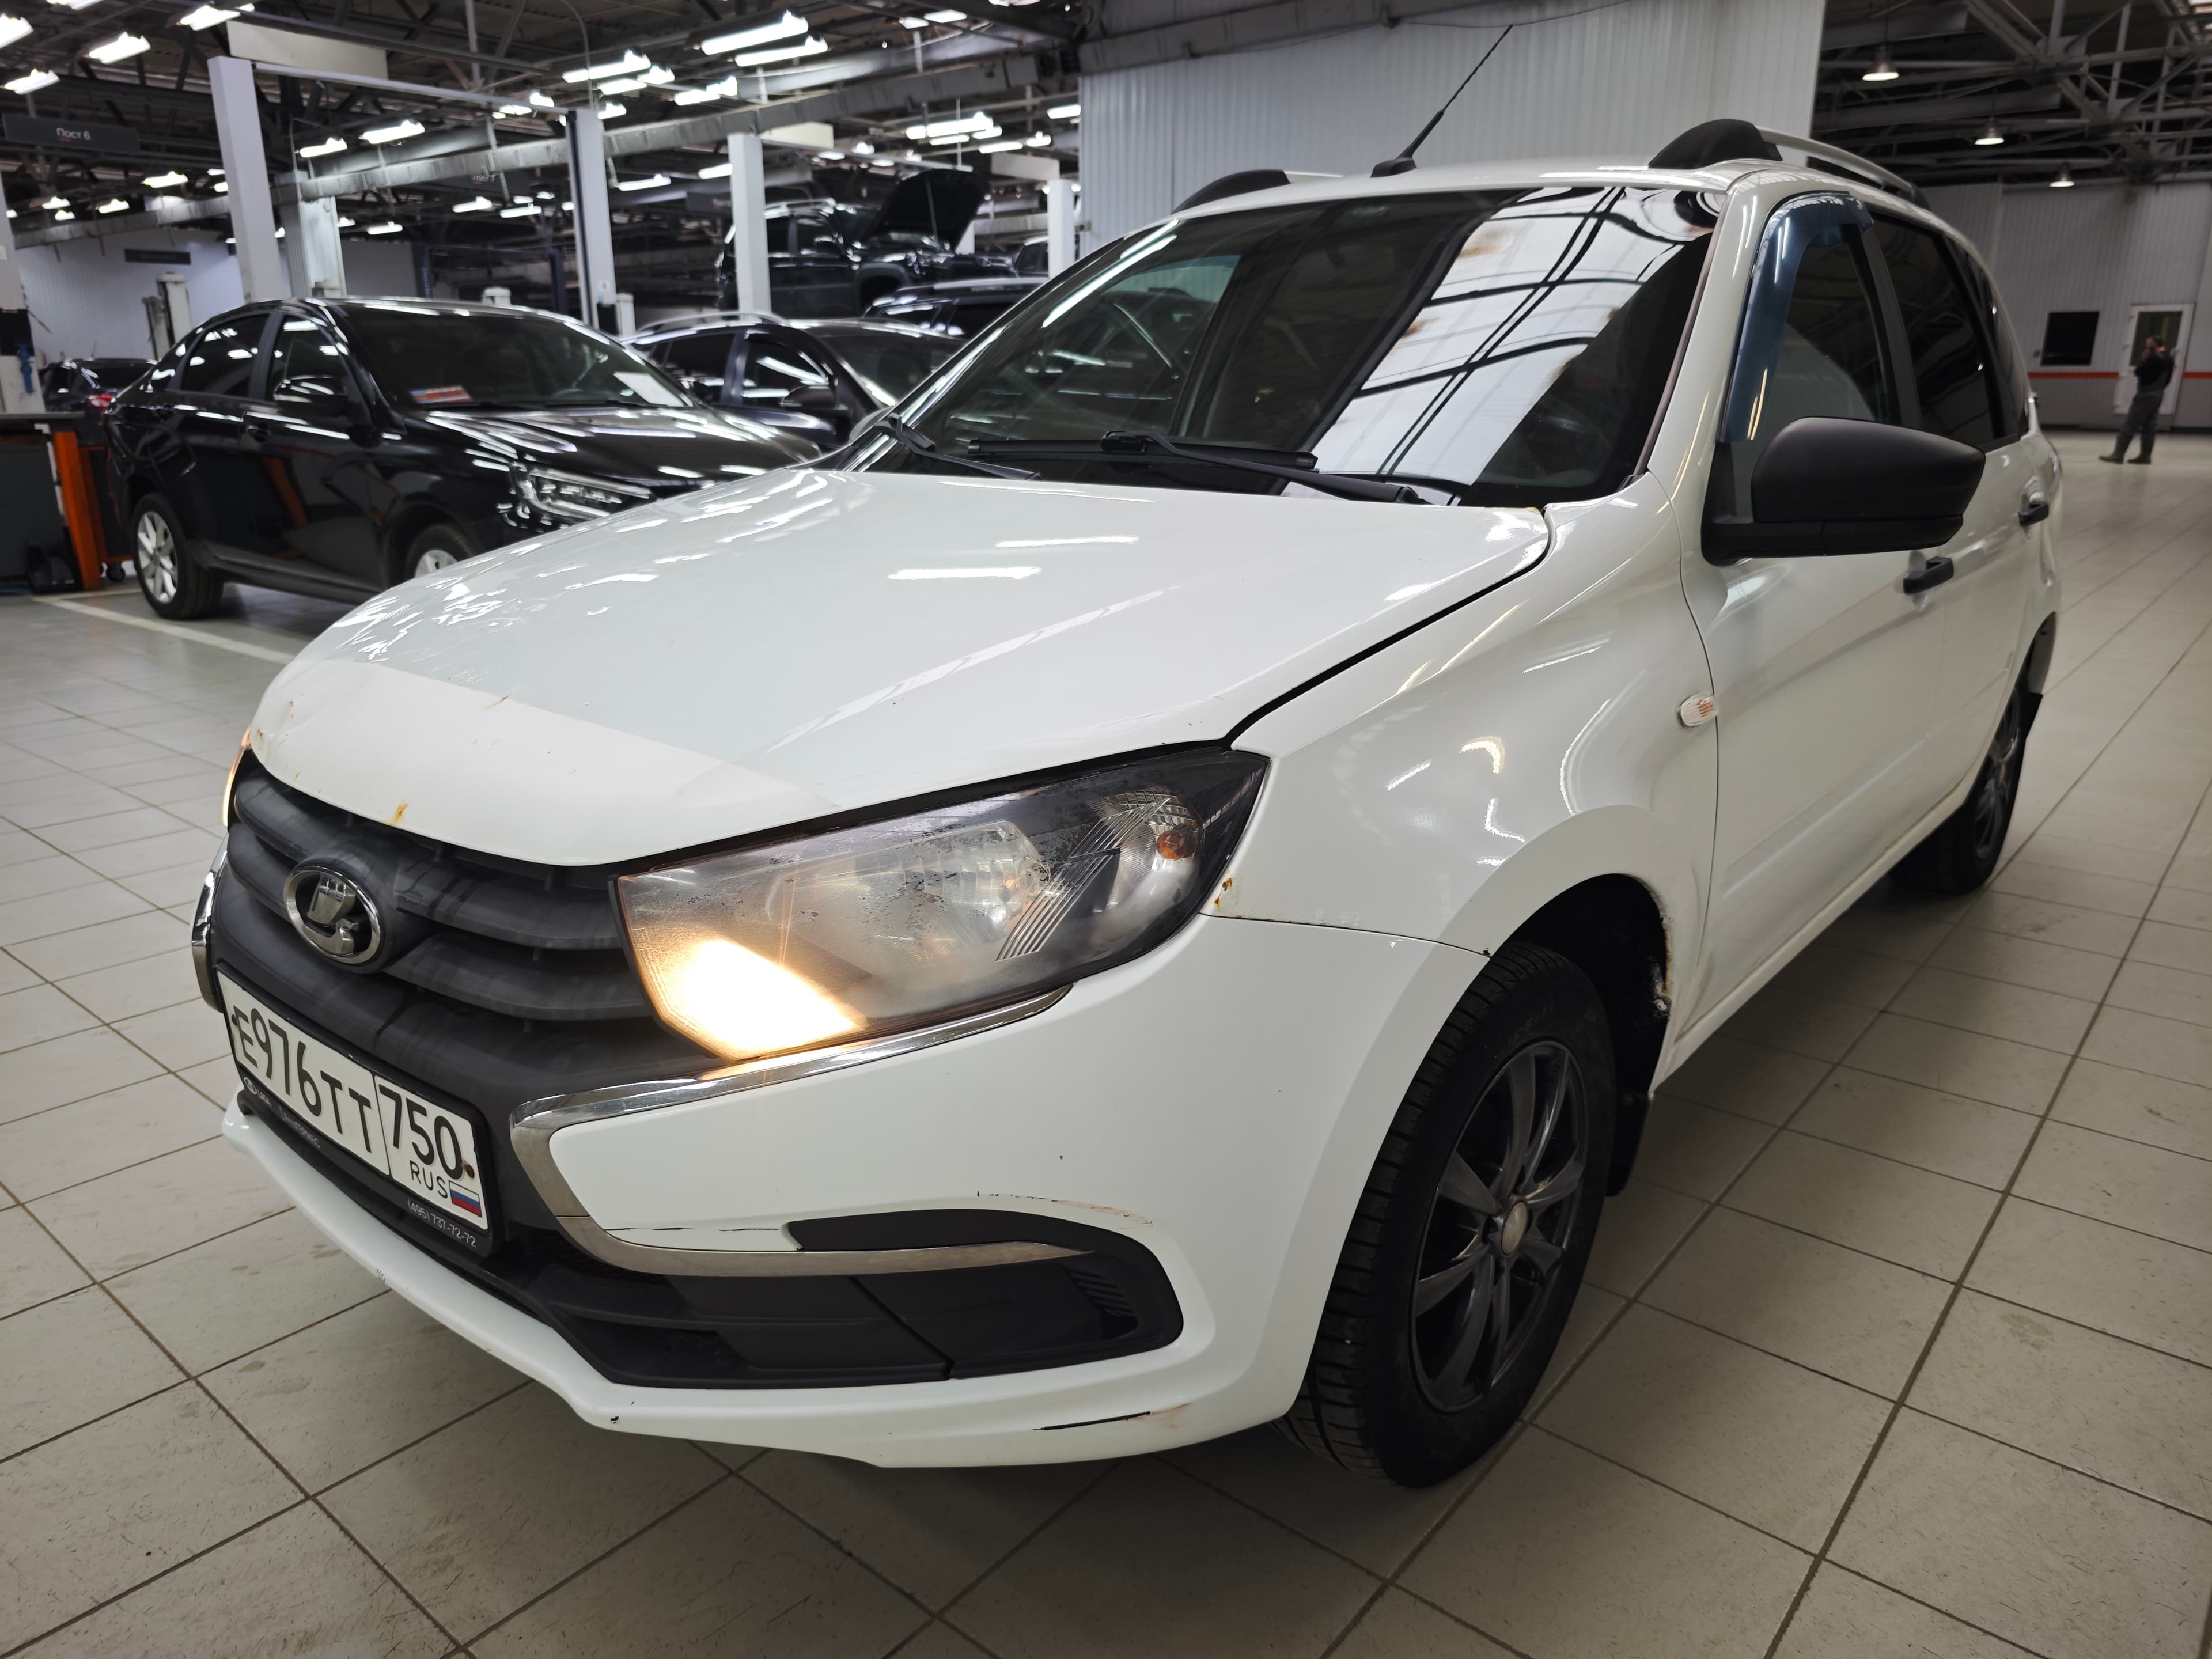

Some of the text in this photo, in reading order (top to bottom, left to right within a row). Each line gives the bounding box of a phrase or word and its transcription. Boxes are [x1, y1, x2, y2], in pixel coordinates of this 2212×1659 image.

[56, 127, 91, 140] Пост 6
[234, 1005, 463, 1180] E976TT 750
[410, 1160, 448, 1198] RUS
[407, 1199, 476, 1248] (495) 737-72-72
